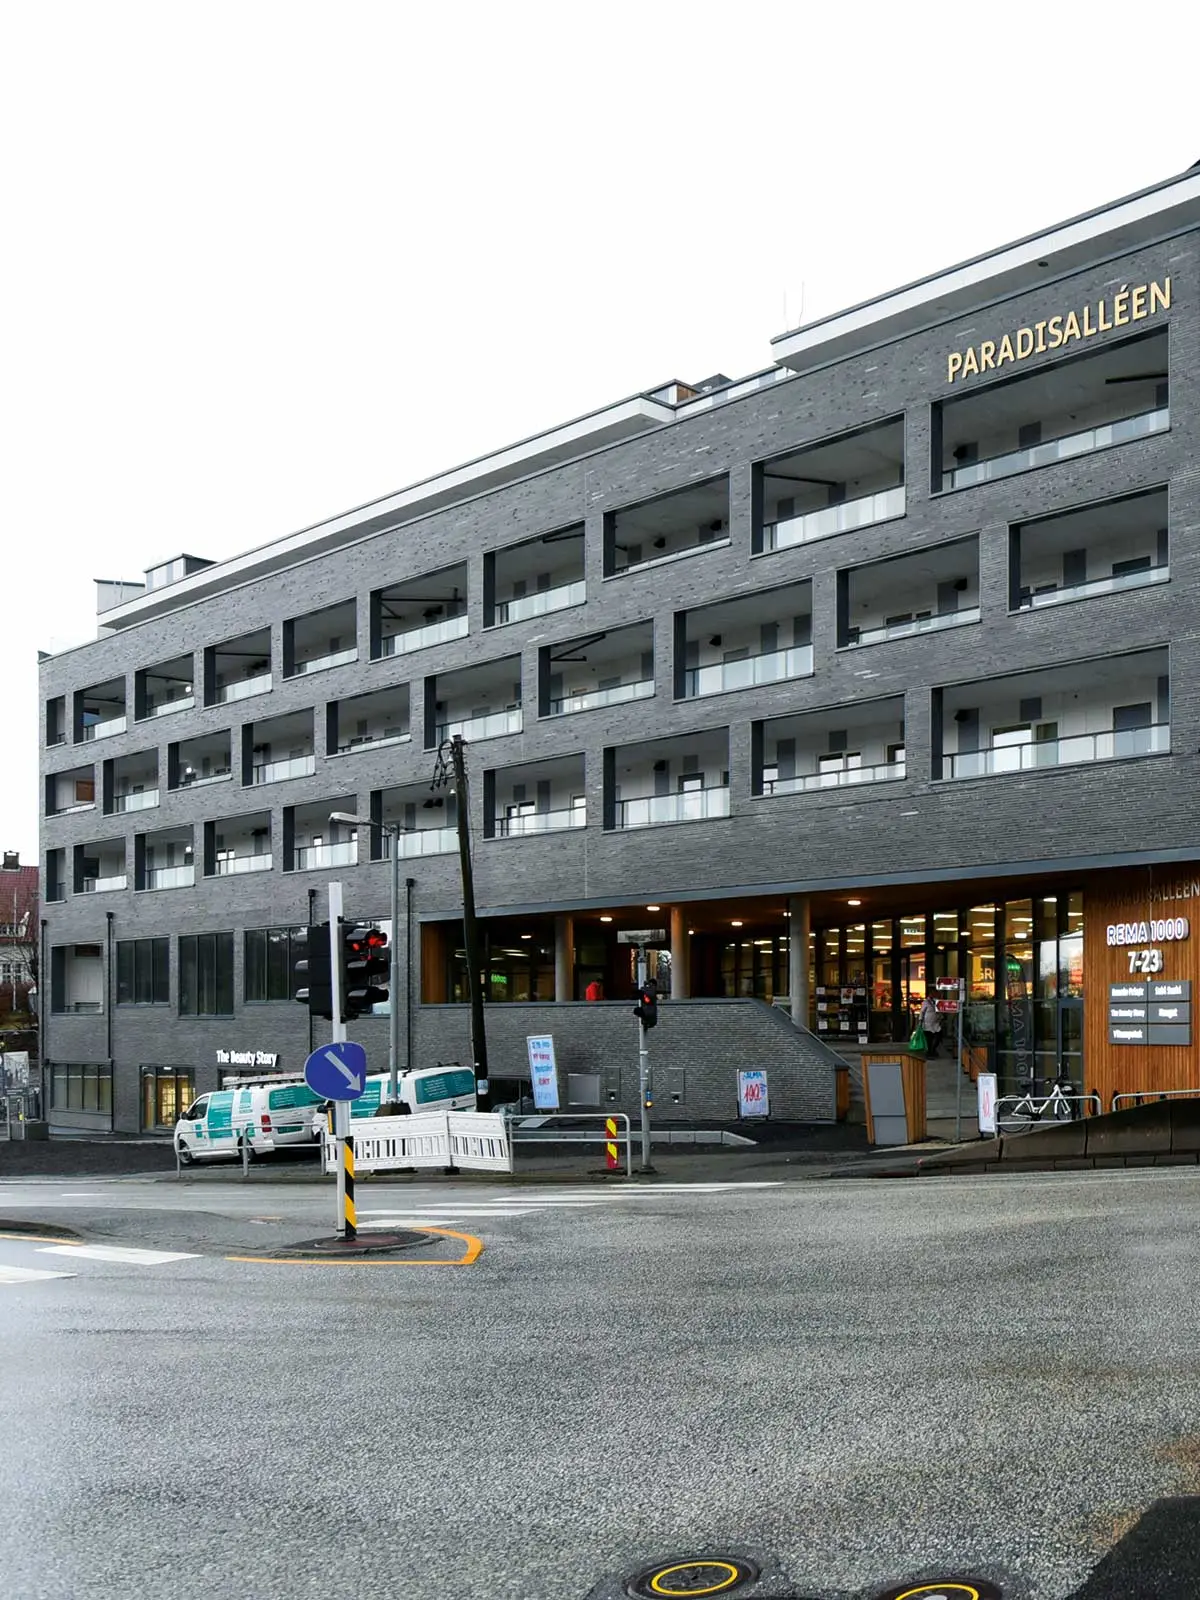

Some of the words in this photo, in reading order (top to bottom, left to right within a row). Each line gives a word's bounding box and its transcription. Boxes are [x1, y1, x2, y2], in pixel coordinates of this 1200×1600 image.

[947, 277, 1172, 384] PARADISALLÉEN
[1106, 922, 1149, 946] REMA
[1150, 917, 1188, 942] 1000
[1127, 949, 1162, 974] 7-23
[216, 1049, 230, 1063] The
[230, 1050, 256, 1067] Beauty
[256, 1050, 278, 1067] Story
